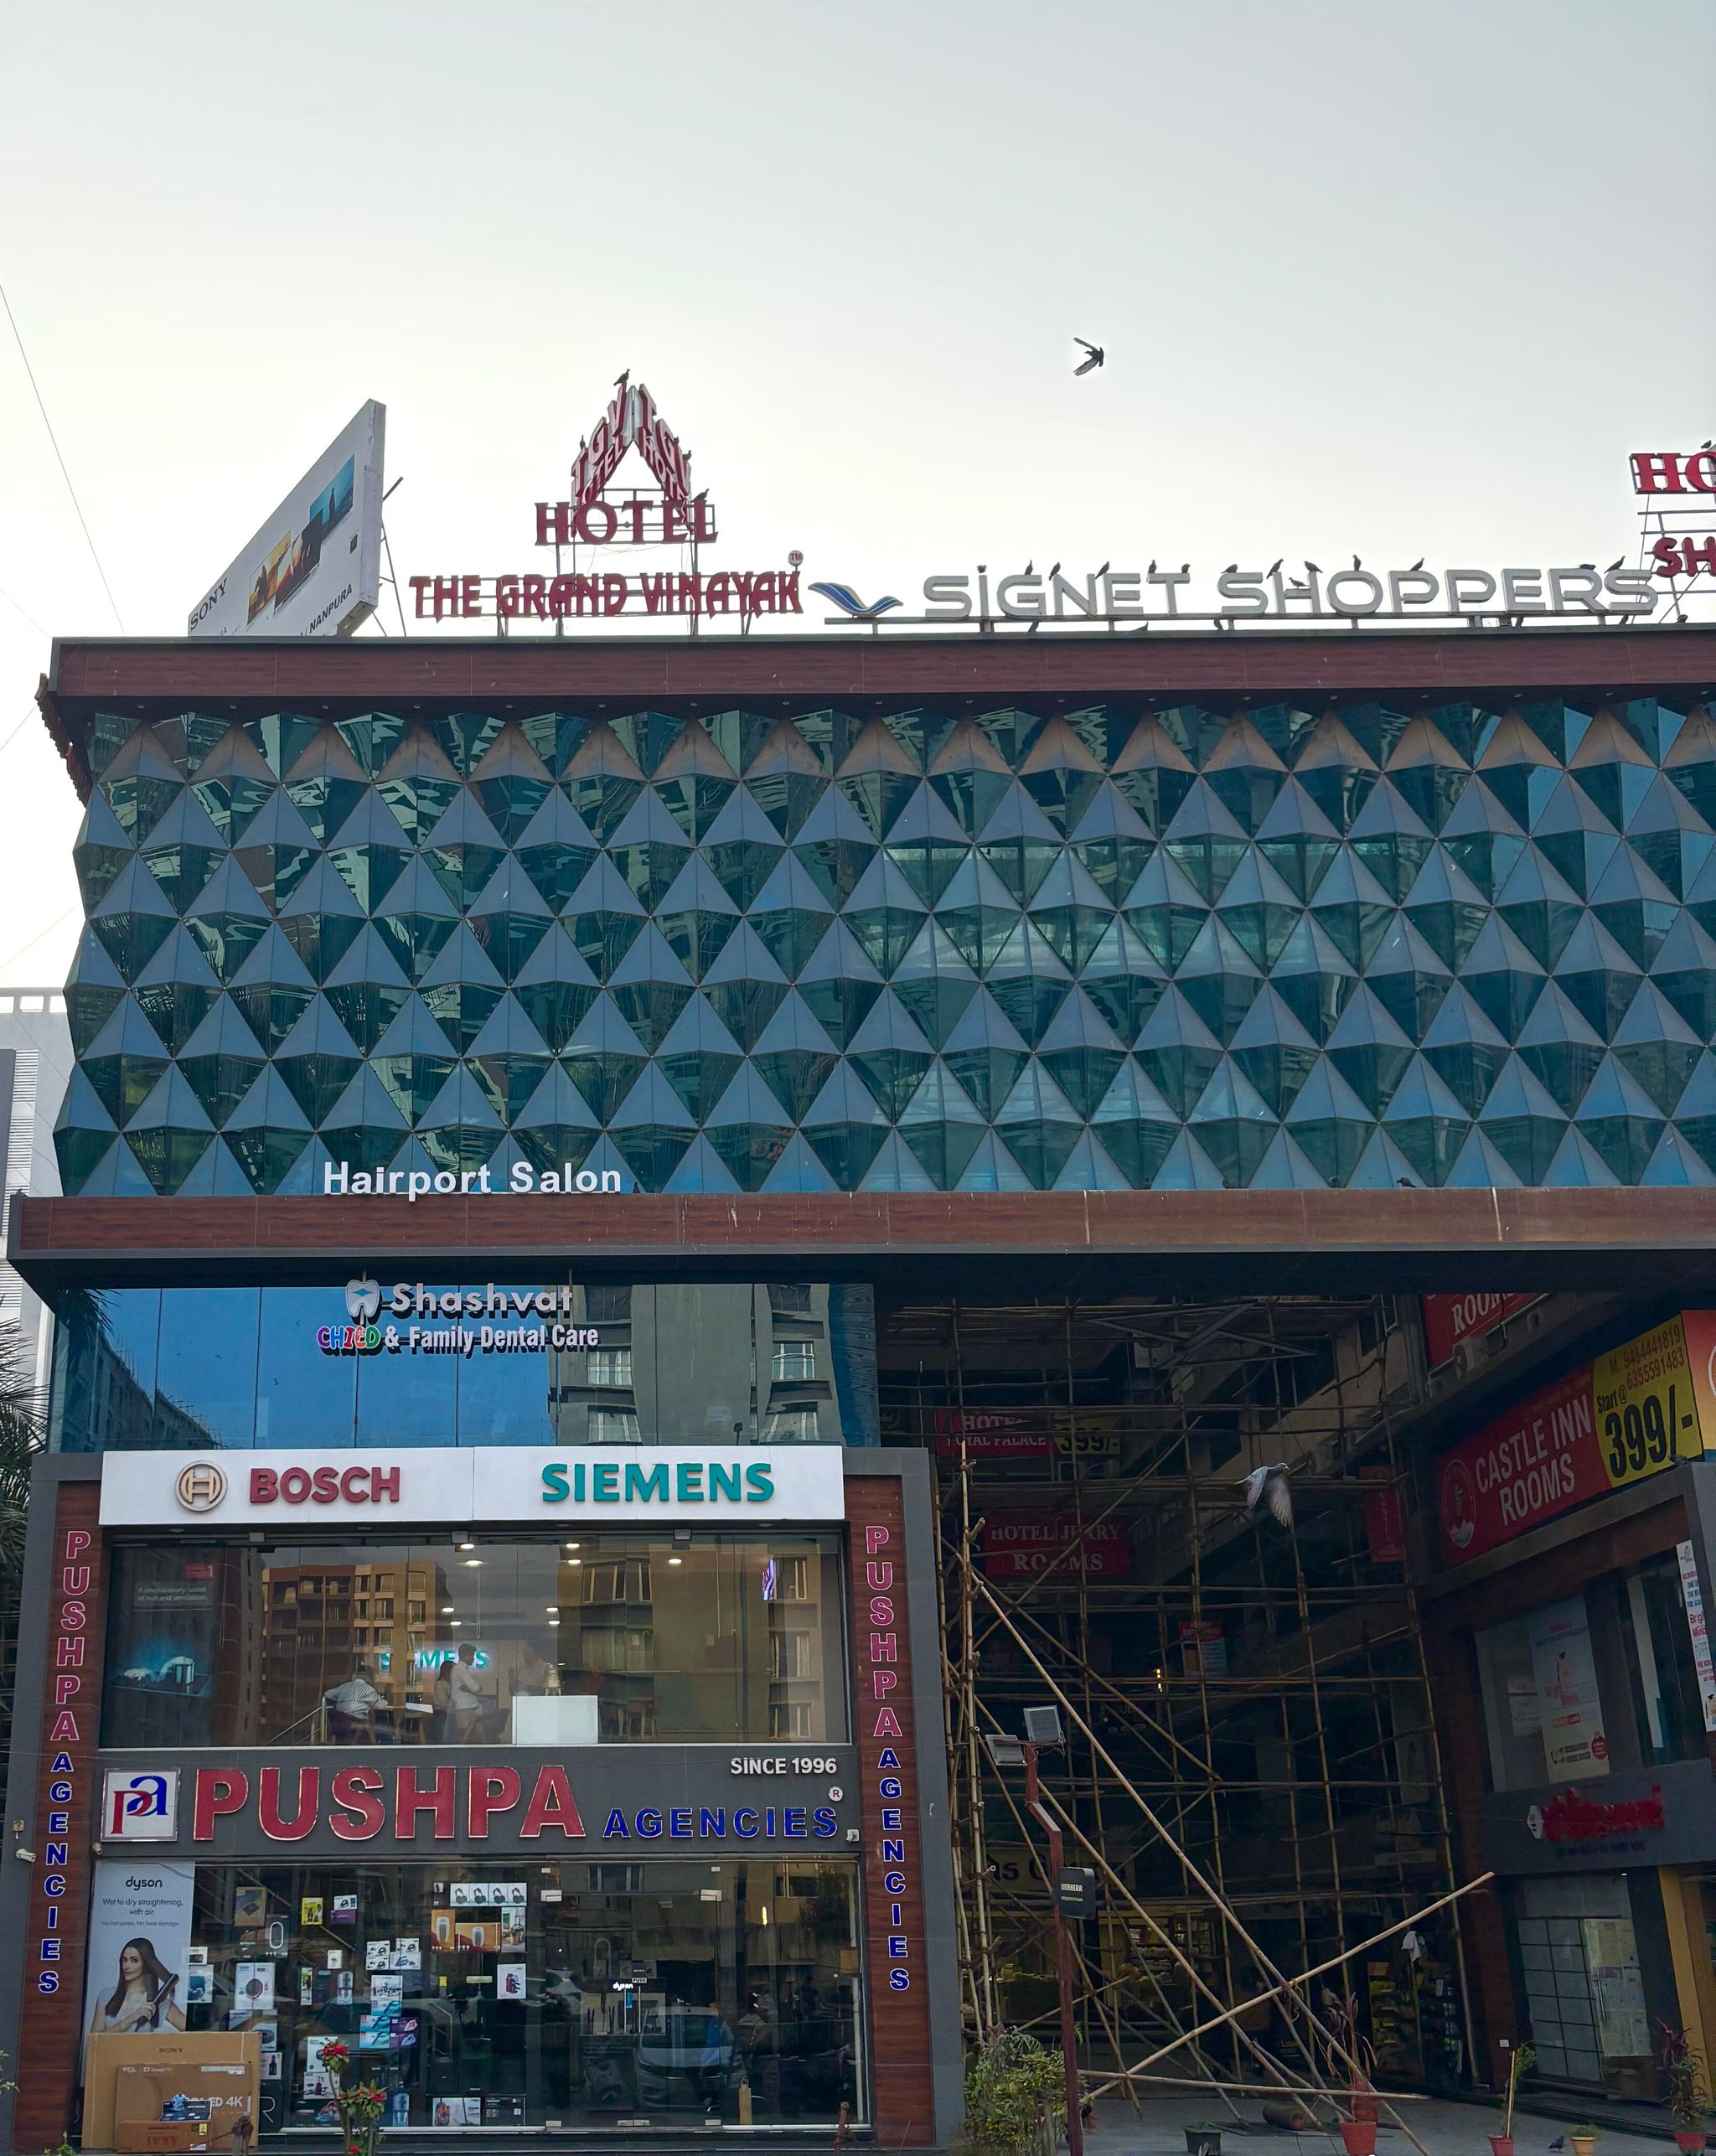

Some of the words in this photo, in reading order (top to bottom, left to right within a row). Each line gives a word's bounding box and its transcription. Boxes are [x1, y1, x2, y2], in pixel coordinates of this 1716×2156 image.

[535, 500, 719, 545] HOTEL
[190, 578, 228, 631] SONY
[309, 584, 353, 634] NANPURA
[409, 575, 483, 623] THE
[497, 573, 628, 622] GRAND
[639, 571, 804, 618] VINAYAK
[923, 572, 1191, 620] SIGNET
[1217, 567, 1659, 618] SHOPPERS
[323, 1161, 490, 1202] Hairport
[510, 1161, 620, 1194] Salon
[390, 1283, 573, 1313] Shashvat
[317, 1326, 380, 1350] CHILD
[385, 1326, 399, 1347] &
[410, 1326, 473, 1352] Family
[481, 1325, 545, 1347] Dental
[552, 1324, 598, 1346] Care
[1597, 1388, 1618, 1414] Start
[1476, 1419, 1548, 1493] CASTLE
[1551, 1394, 1591, 1450] INN
[1605, 1384, 1693, 1478] 399/-
[251, 1466, 401, 1502] BOSCH
[540, 1462, 775, 1502] SIEMENS
[1500, 1453, 1575, 1526] ROOMS
[50, 1531, 90, 1740] PUSHPA
[866, 1525, 902, 1737] PUSHPA
[731, 1758, 786, 1775] SINCE
[791, 1757, 837, 1774] 1996
[193, 1766, 586, 1841] PUSHPA
[602, 1806, 837, 1838] AGENCIES
[39, 1752, 73, 1993] AGENCIES
[125, 1876, 163, 1890] dyson
[878, 1748, 910, 1991] AGENCIES
[126, 1899, 137, 1907] dry
